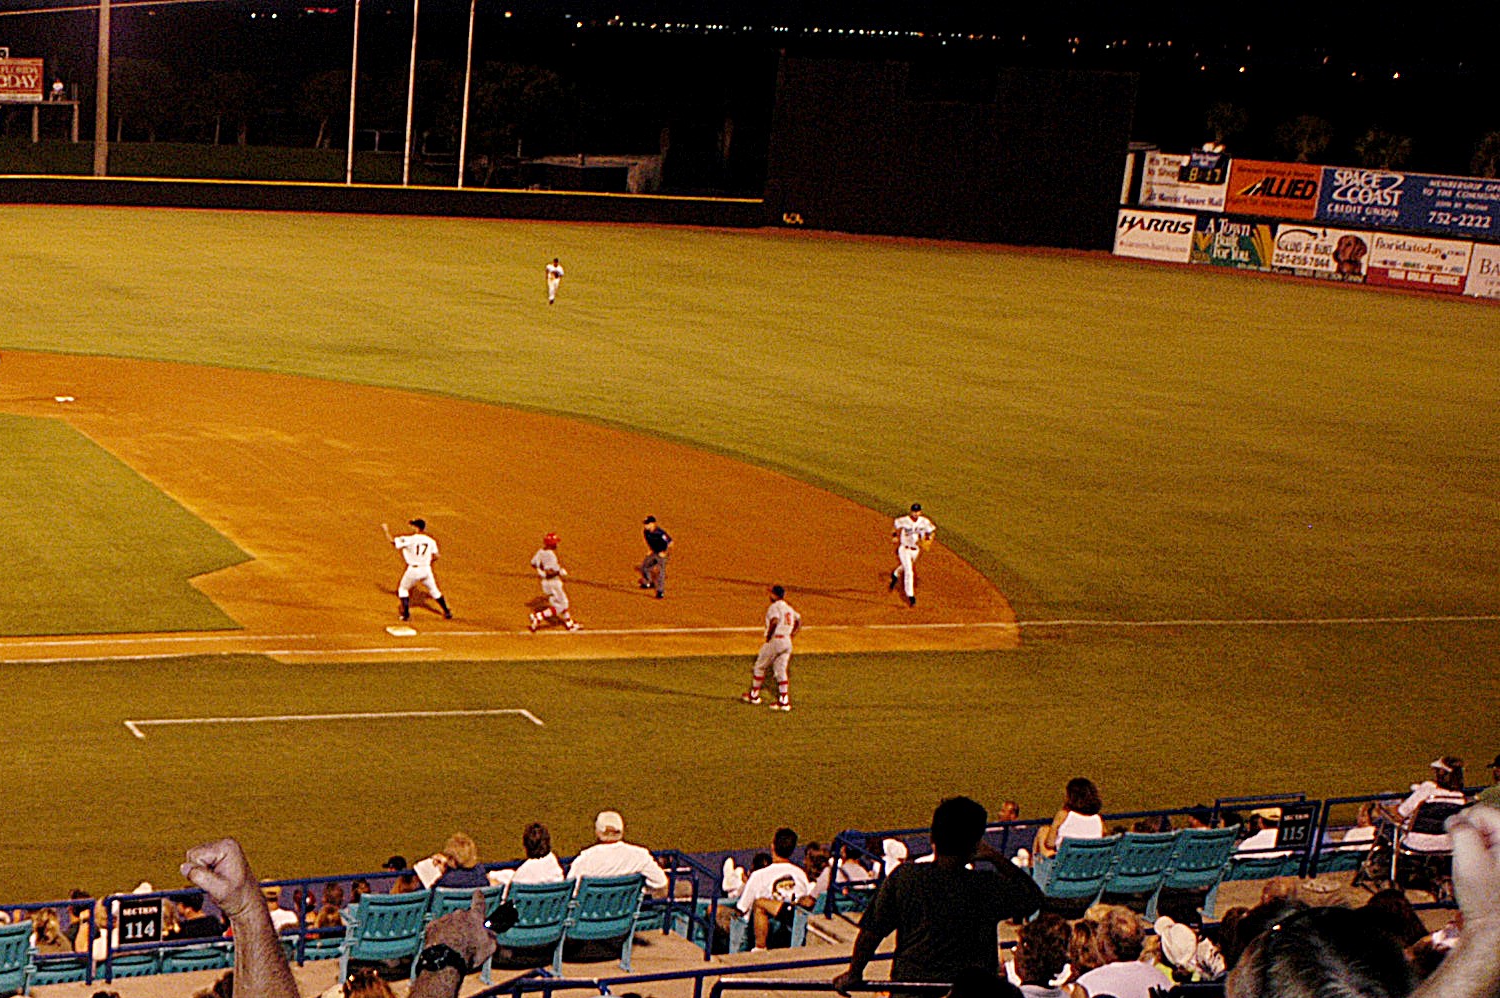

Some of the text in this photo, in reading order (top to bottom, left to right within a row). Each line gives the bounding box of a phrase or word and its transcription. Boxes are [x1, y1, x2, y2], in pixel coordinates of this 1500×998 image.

[1333, 169, 1382, 188] SPACE
[1244, 176, 1317, 200] ALLIED
[1346, 186, 1403, 206] COAST
[1327, 203, 1362, 214] CREDIT
[1365, 206, 1399, 218] UNION
[1428, 211, 1493, 228] 752-2222
[1118, 215, 1193, 236] HARRIS
[416, 543, 428, 556] 17
[1282, 826, 1305, 841] 115
[122, 906, 158, 916] SECTION
[125, 920, 155, 939] 114
